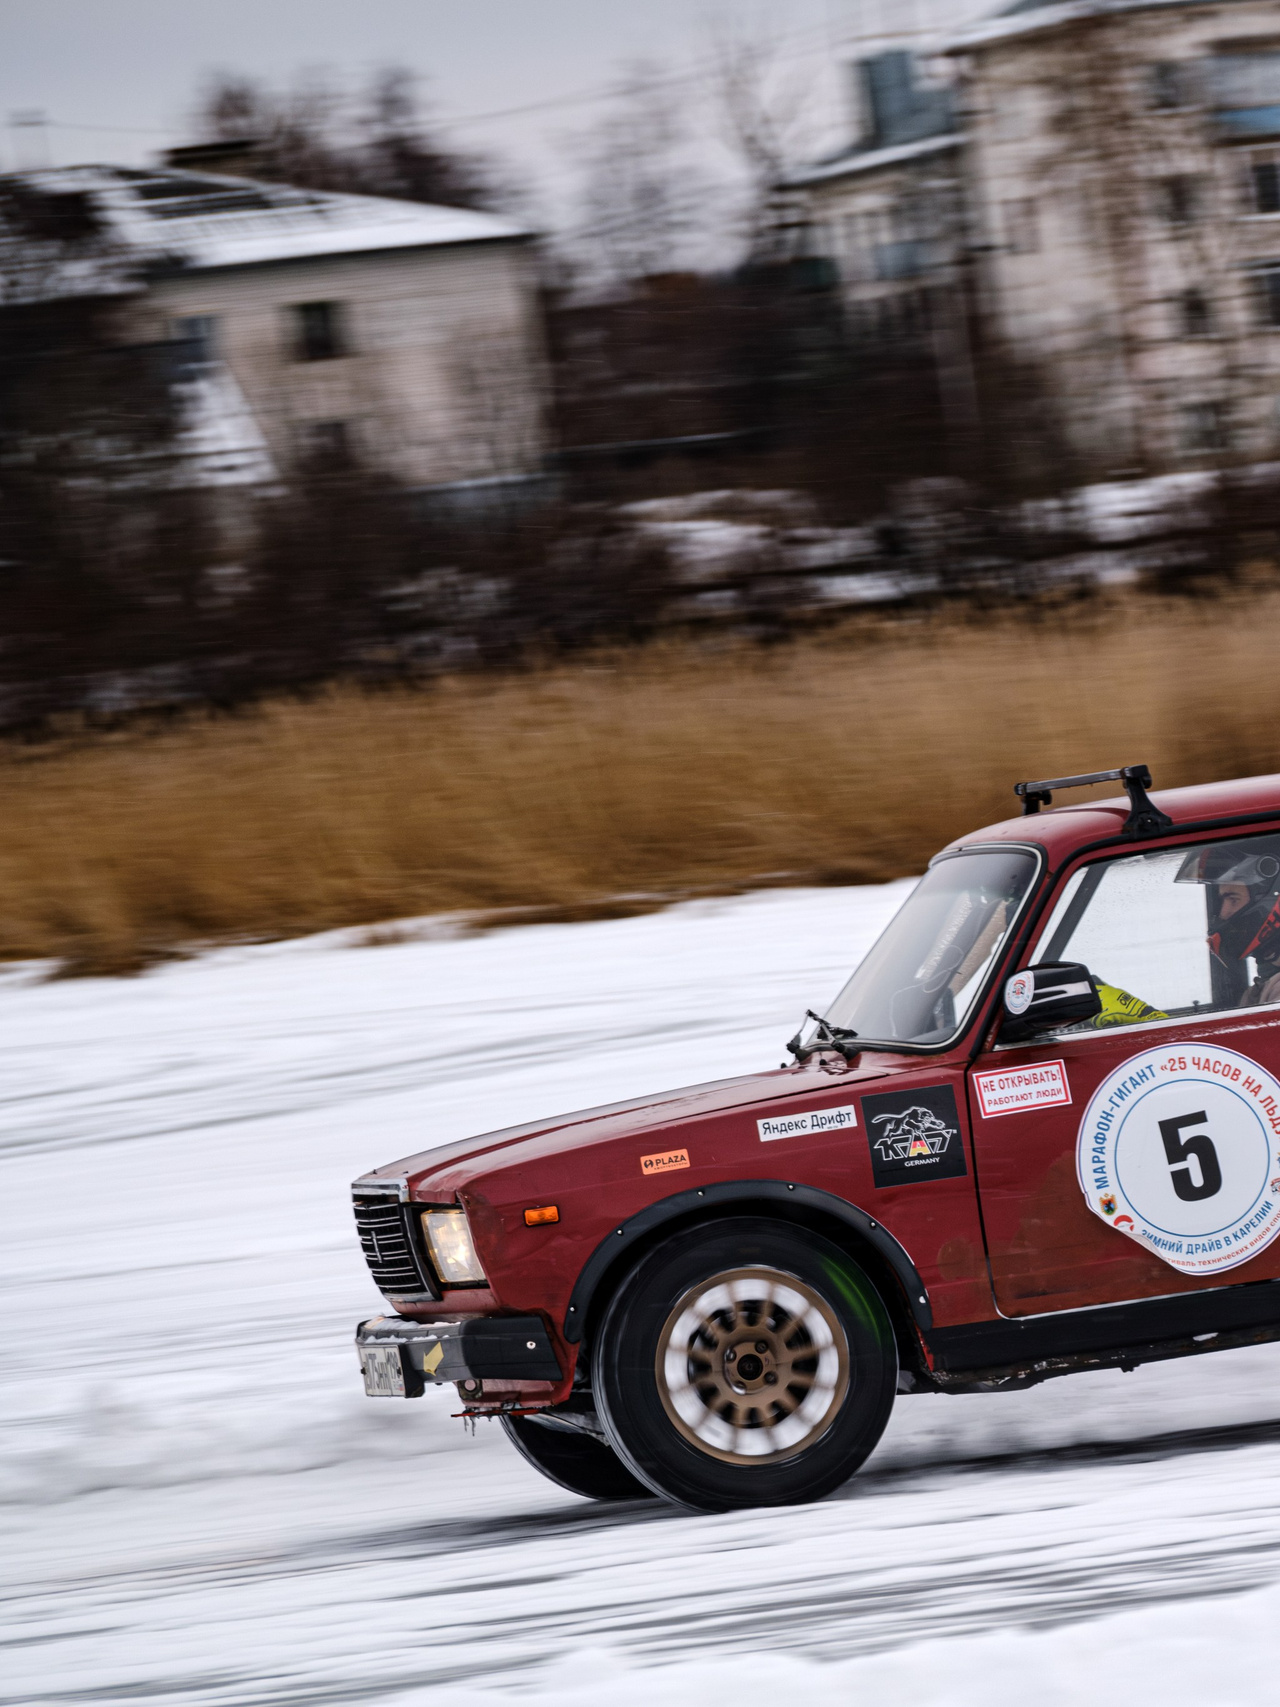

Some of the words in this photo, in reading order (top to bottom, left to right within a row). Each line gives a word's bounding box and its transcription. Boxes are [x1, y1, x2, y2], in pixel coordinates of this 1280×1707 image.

[981, 1080, 996, 1093] НЕ
[998, 1068, 1062, 1090] ОТКРЫВАТЬ!
[1160, 1056, 1187, 1072] «25
[1191, 1056, 1242, 1082] ЧАСОВ
[1241, 1075, 1263, 1097] НА
[987, 1092, 1033, 1107] РАБОТАЮТ
[1035, 1087, 1064, 1099] ЛЮДИ
[762, 1120, 808, 1135] Яндекс
[810, 1110, 852, 1130] Дрифт
[1091, 1063, 1157, 1190] МАРАФОН-ГИГАНТ
[655, 1154, 687, 1166] PLAZA
[904, 1157, 940, 1167] GERMANY
[1157, 1109, 1223, 1203] 5
[1185, 1238, 1223, 1255] ДРАЙВ
[1224, 1235, 1233, 1246] В
[1233, 1200, 1275, 1242] КАРЕЛИИ
[1165, 1257, 1196, 1267] тиваль
[1198, 1245, 1250, 1267] технических
[1249, 1227, 1271, 1246] видов
